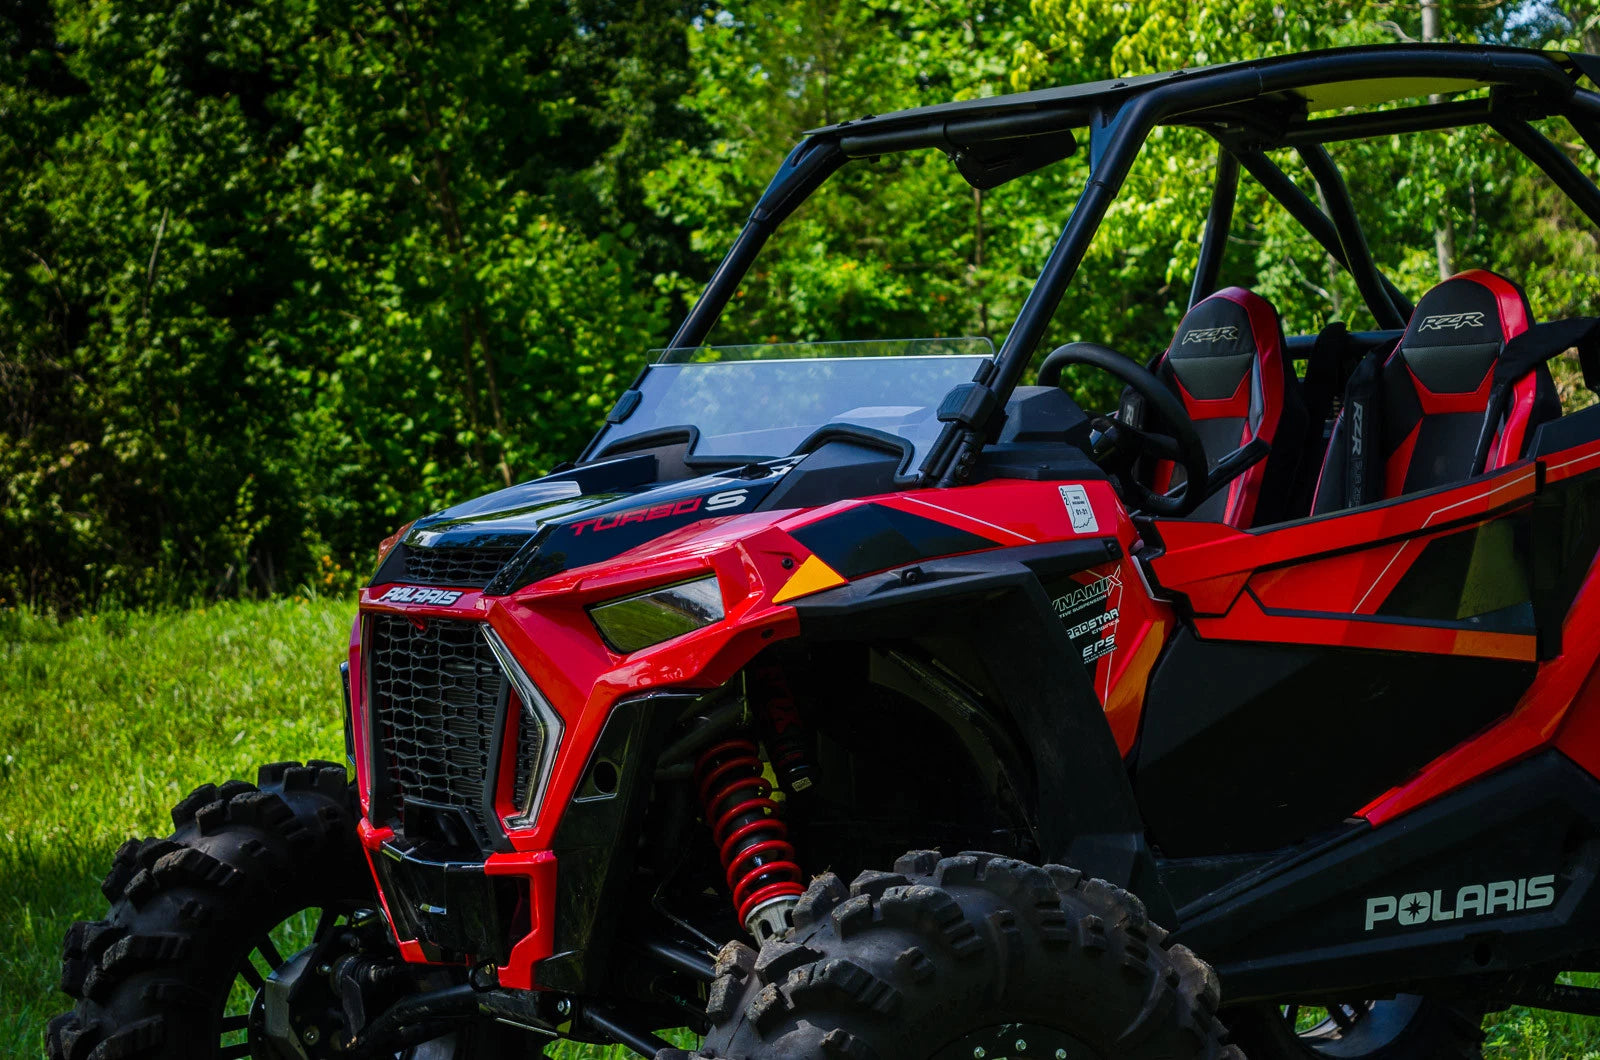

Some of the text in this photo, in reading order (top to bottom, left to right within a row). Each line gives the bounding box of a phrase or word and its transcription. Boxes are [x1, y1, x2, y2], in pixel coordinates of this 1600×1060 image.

[1418, 311, 1485, 332] RZR
[1181, 326, 1239, 345] RZR
[1351, 401, 1364, 456] RZR
[569, 488, 749, 536] TURBO S
[379, 587, 463, 605] POLARIS
[1082, 633, 1115, 658] EPS
[1364, 874, 1555, 931] POLARIS
